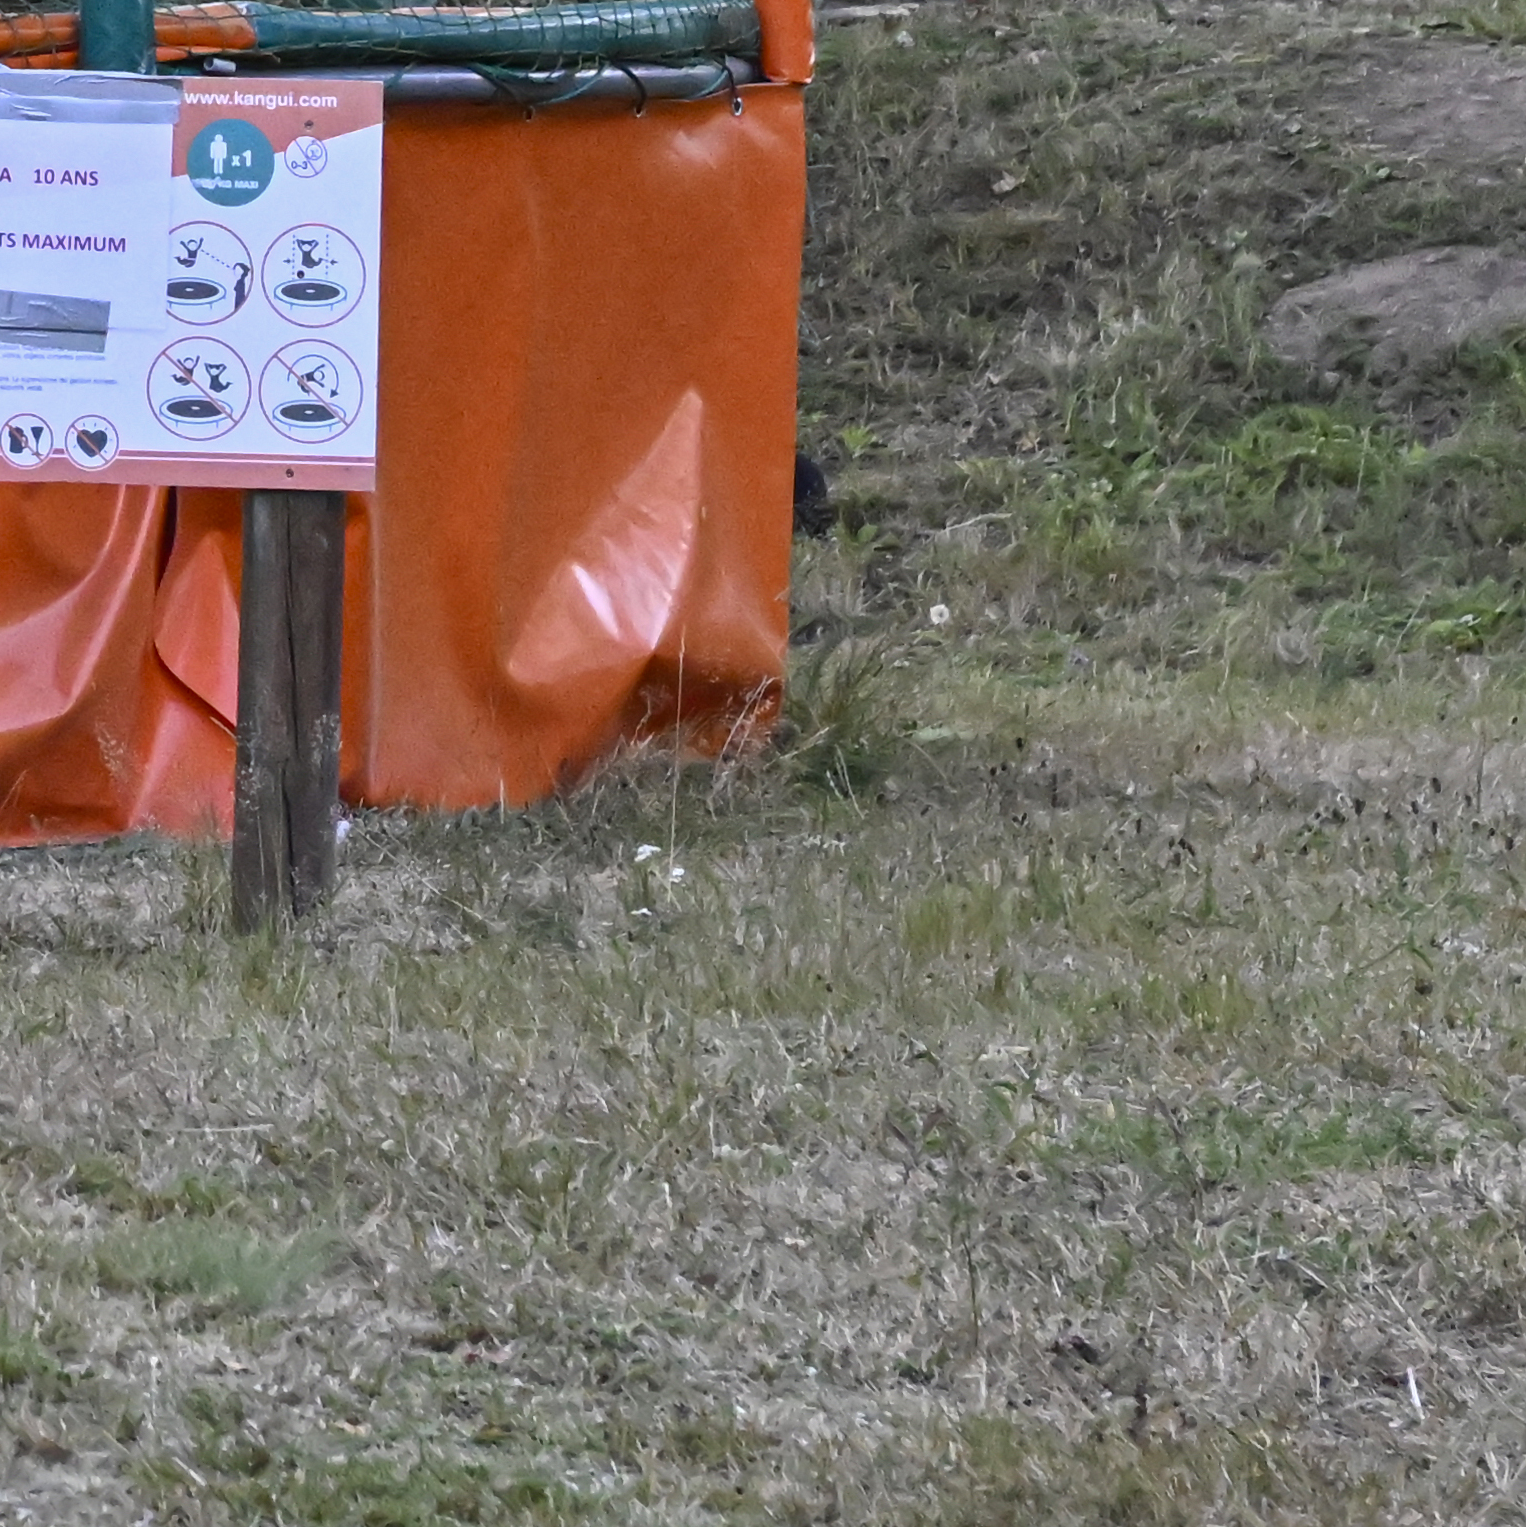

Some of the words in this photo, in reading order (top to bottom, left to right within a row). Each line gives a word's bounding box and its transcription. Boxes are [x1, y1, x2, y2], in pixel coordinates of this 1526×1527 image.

[184, 90, 338, 110] www.kangui.com
[33, 168, 56, 185] 10
[60, 170, 99, 187] ANS
[22, 233, 127, 253] MAXIMUM
